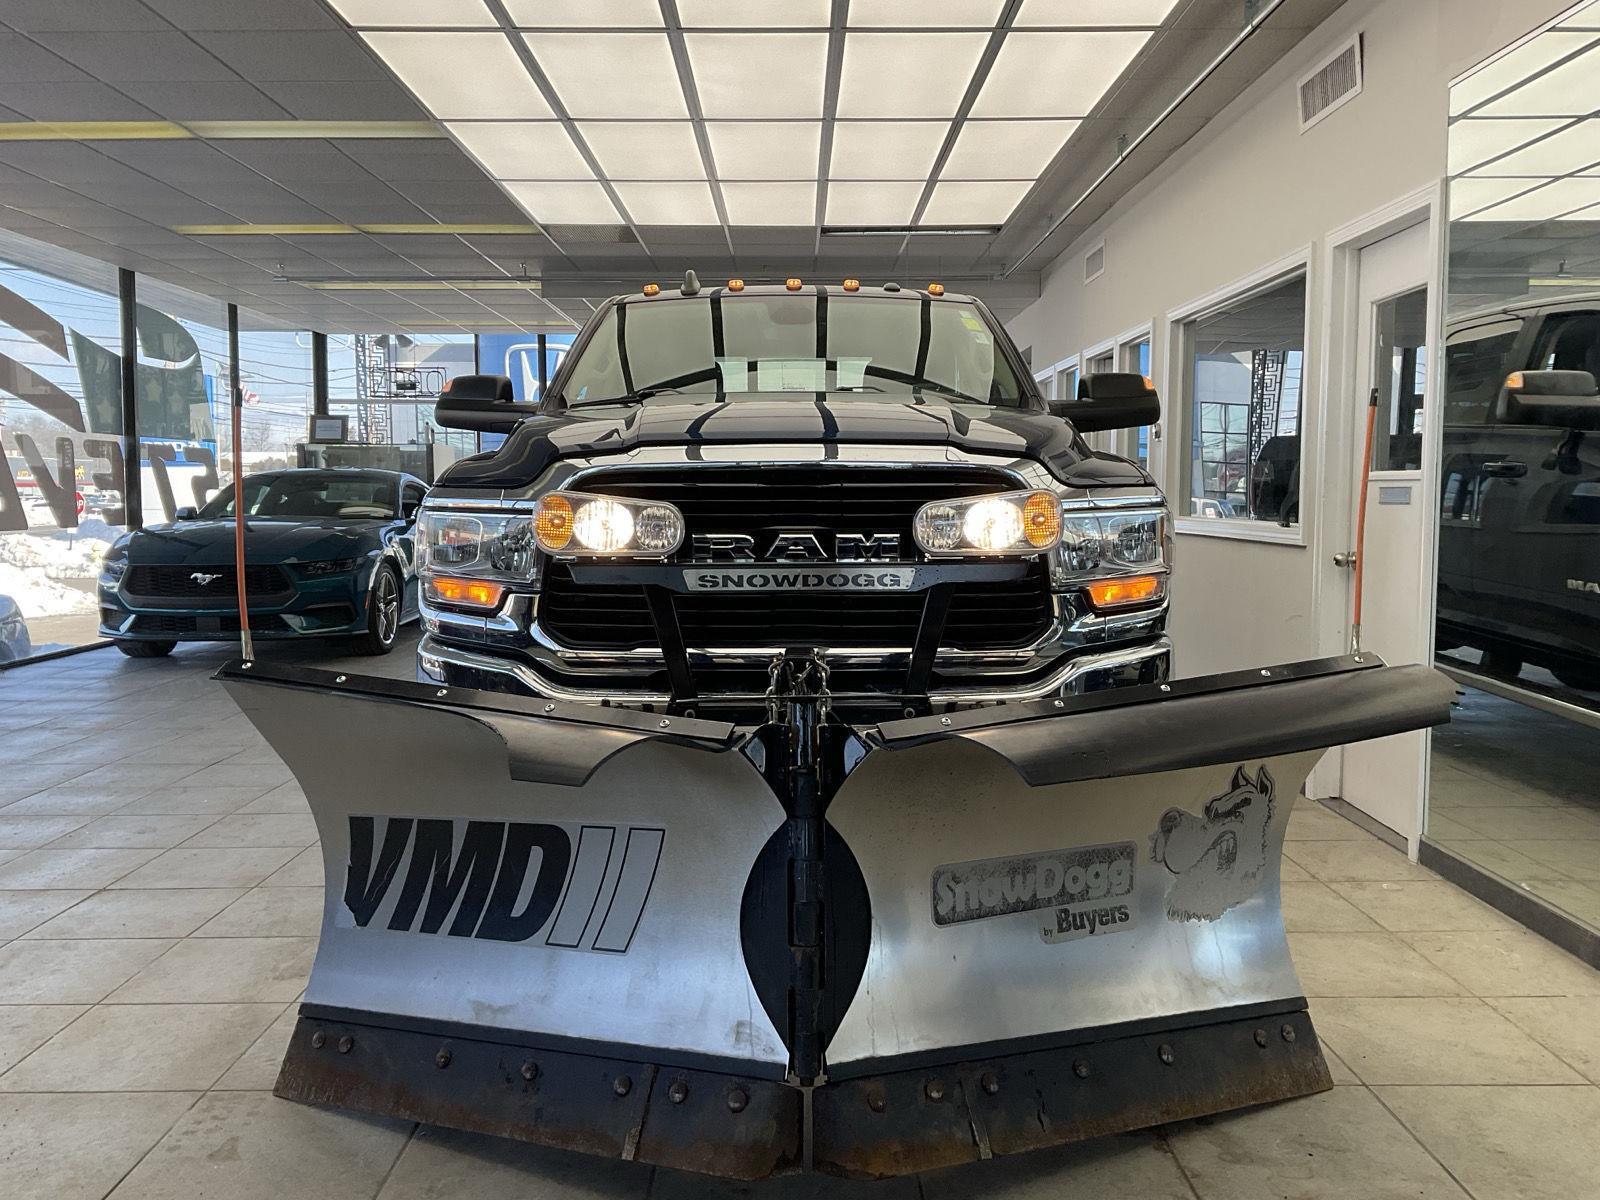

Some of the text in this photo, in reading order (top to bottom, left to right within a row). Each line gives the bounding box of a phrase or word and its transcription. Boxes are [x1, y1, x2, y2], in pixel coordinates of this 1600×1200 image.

[692, 531, 900, 562] RAM
[697, 573, 901, 589] SNOWDOGG
[936, 859, 1133, 915] SnowDogg
[1043, 903, 1131, 938] by Buyers
